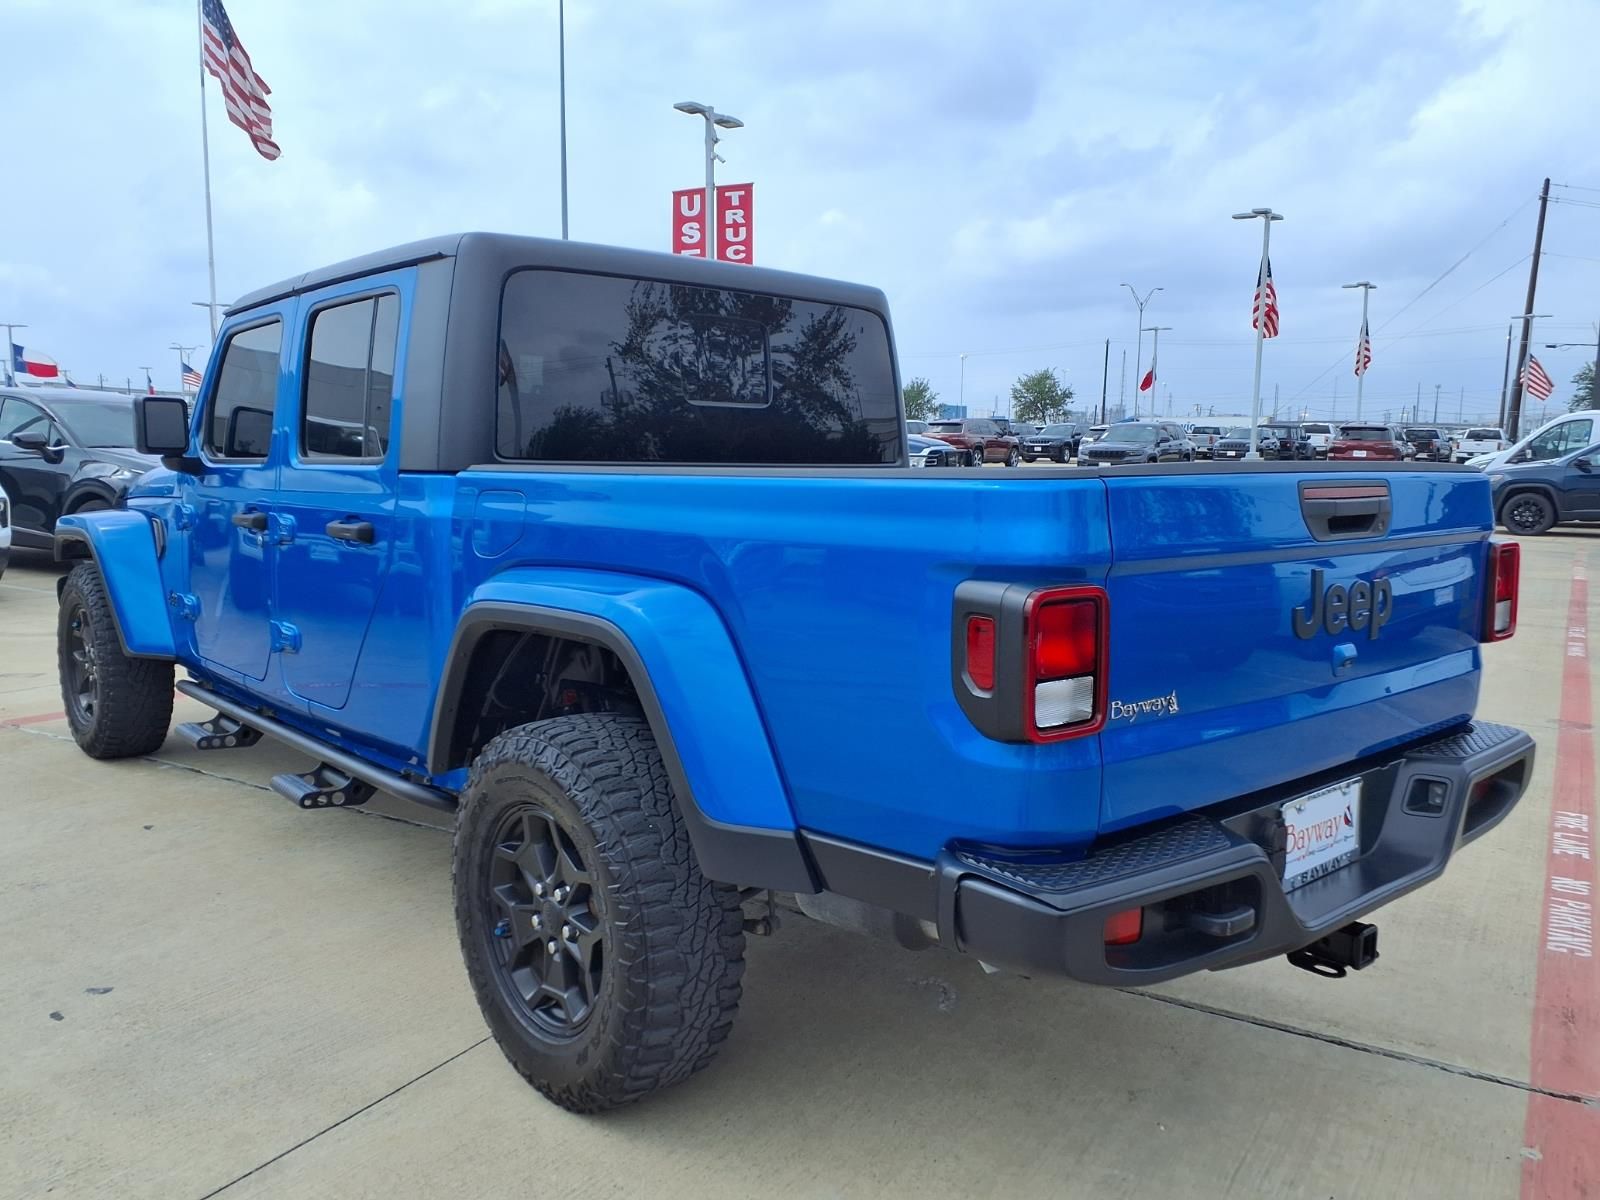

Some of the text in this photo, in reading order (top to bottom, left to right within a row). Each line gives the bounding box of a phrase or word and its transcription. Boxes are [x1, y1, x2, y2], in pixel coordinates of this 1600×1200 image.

[1293, 568, 1392, 640] Jeep
[1111, 696, 1172, 723] Bayway
[1285, 815, 1342, 856] Bayway
[1547, 876, 1592, 957] NO PARKING
